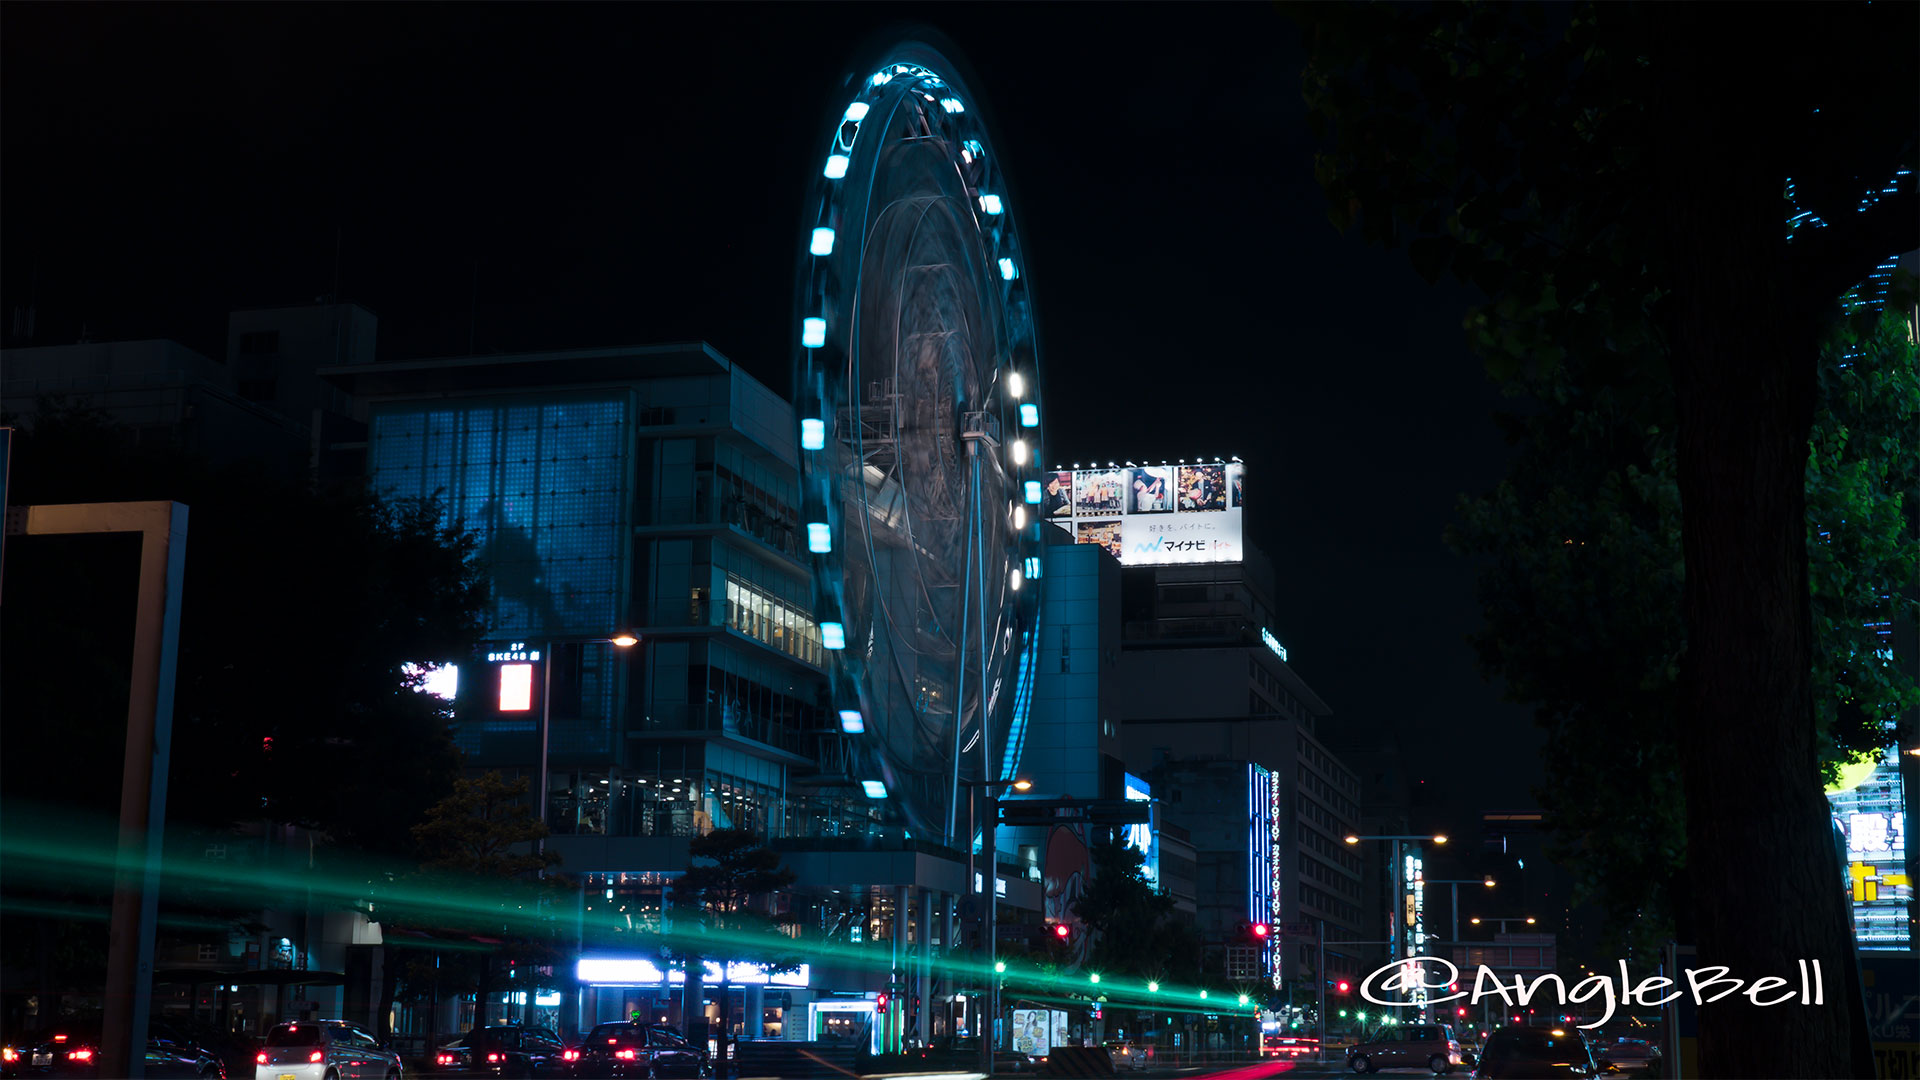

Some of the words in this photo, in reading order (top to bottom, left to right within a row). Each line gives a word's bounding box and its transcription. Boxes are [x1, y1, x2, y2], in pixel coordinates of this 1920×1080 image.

[1164, 540, 1205, 551] マイナビ
[511, 643, 525, 651] 2F
[488, 652, 527, 661] SKE48
